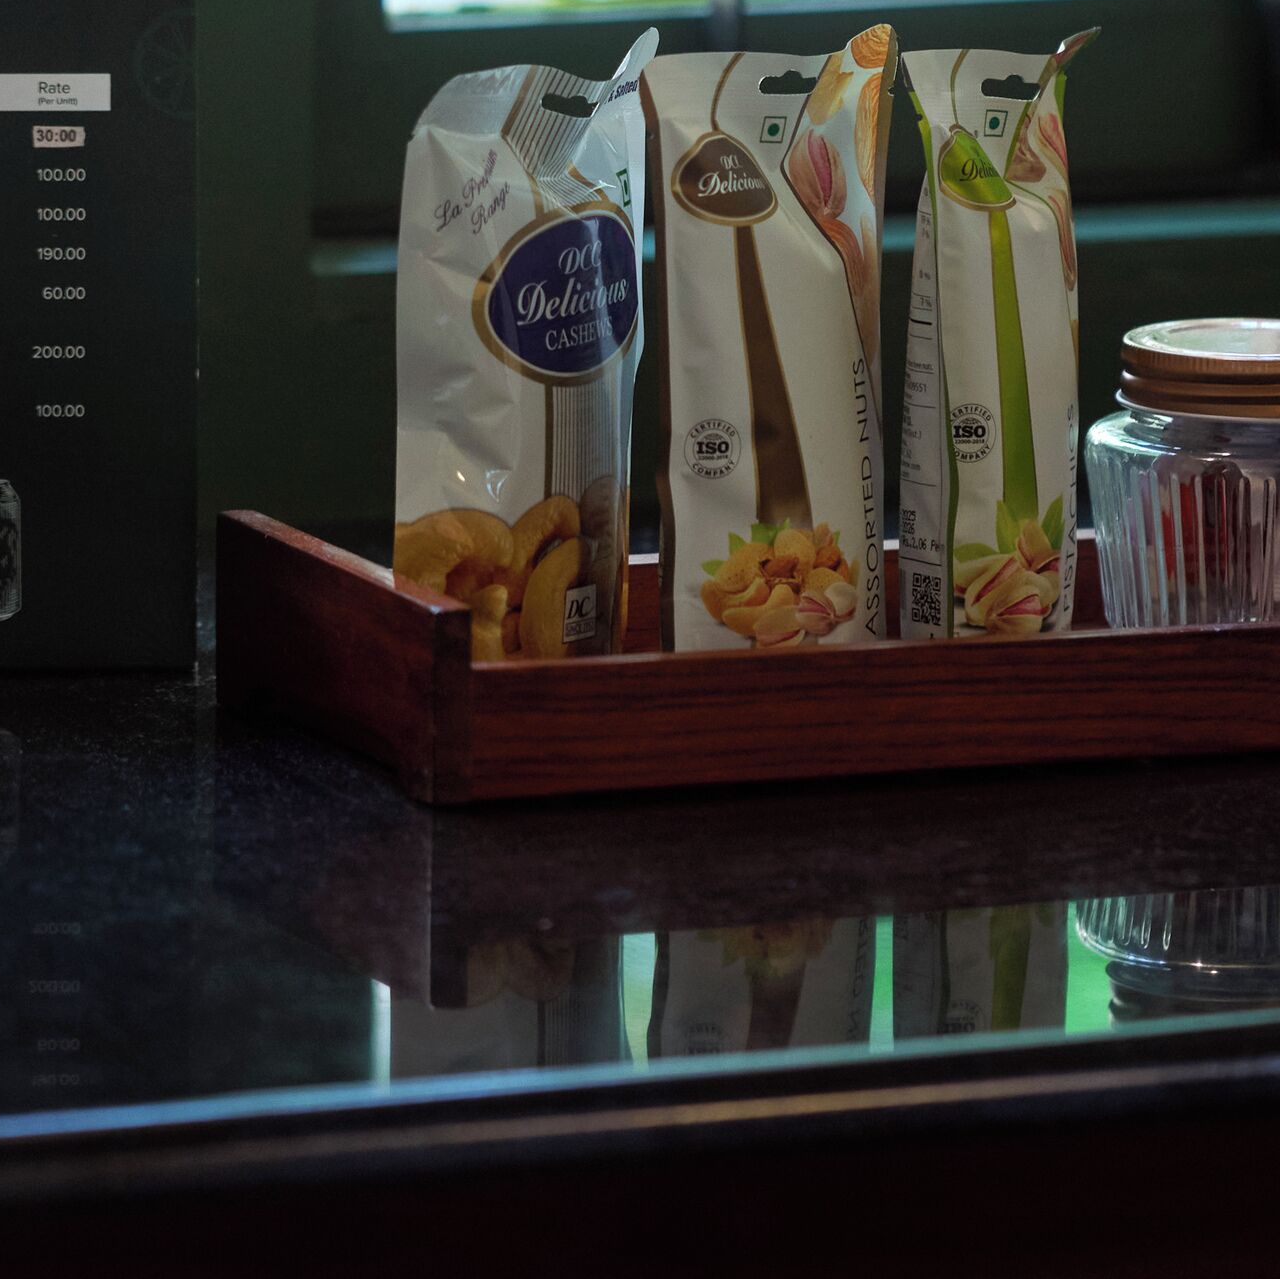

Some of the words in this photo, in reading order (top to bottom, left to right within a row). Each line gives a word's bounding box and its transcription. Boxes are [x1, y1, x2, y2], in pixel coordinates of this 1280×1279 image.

[38, 82, 72, 95] Rate
[37, 97, 55, 107] (Per
[35, 129, 78, 143] 30:00
[37, 168, 88, 182] 100.00
[37, 208, 88, 222] 100.00
[37, 247, 88, 261] 190.00
[558, 240, 602, 275] DCC
[42, 286, 88, 300] 60.00
[516, 277, 630, 326] Delicious
[545, 316, 613, 351] CASHEWS
[32, 345, 87, 360] 200.00
[851, 358, 871, 444] NUTS
[35, 404, 87, 418] 100.00
[951, 406, 991, 422] ERTIFIED
[690, 421, 736, 439] CERTIFIED
[953, 425, 986, 438] ISO
[696, 440, 730, 455] ISO
[953, 444, 990, 461] OMPANY
[692, 459, 735, 477] COMPANY
[861, 455, 881, 636] ASSORTED
